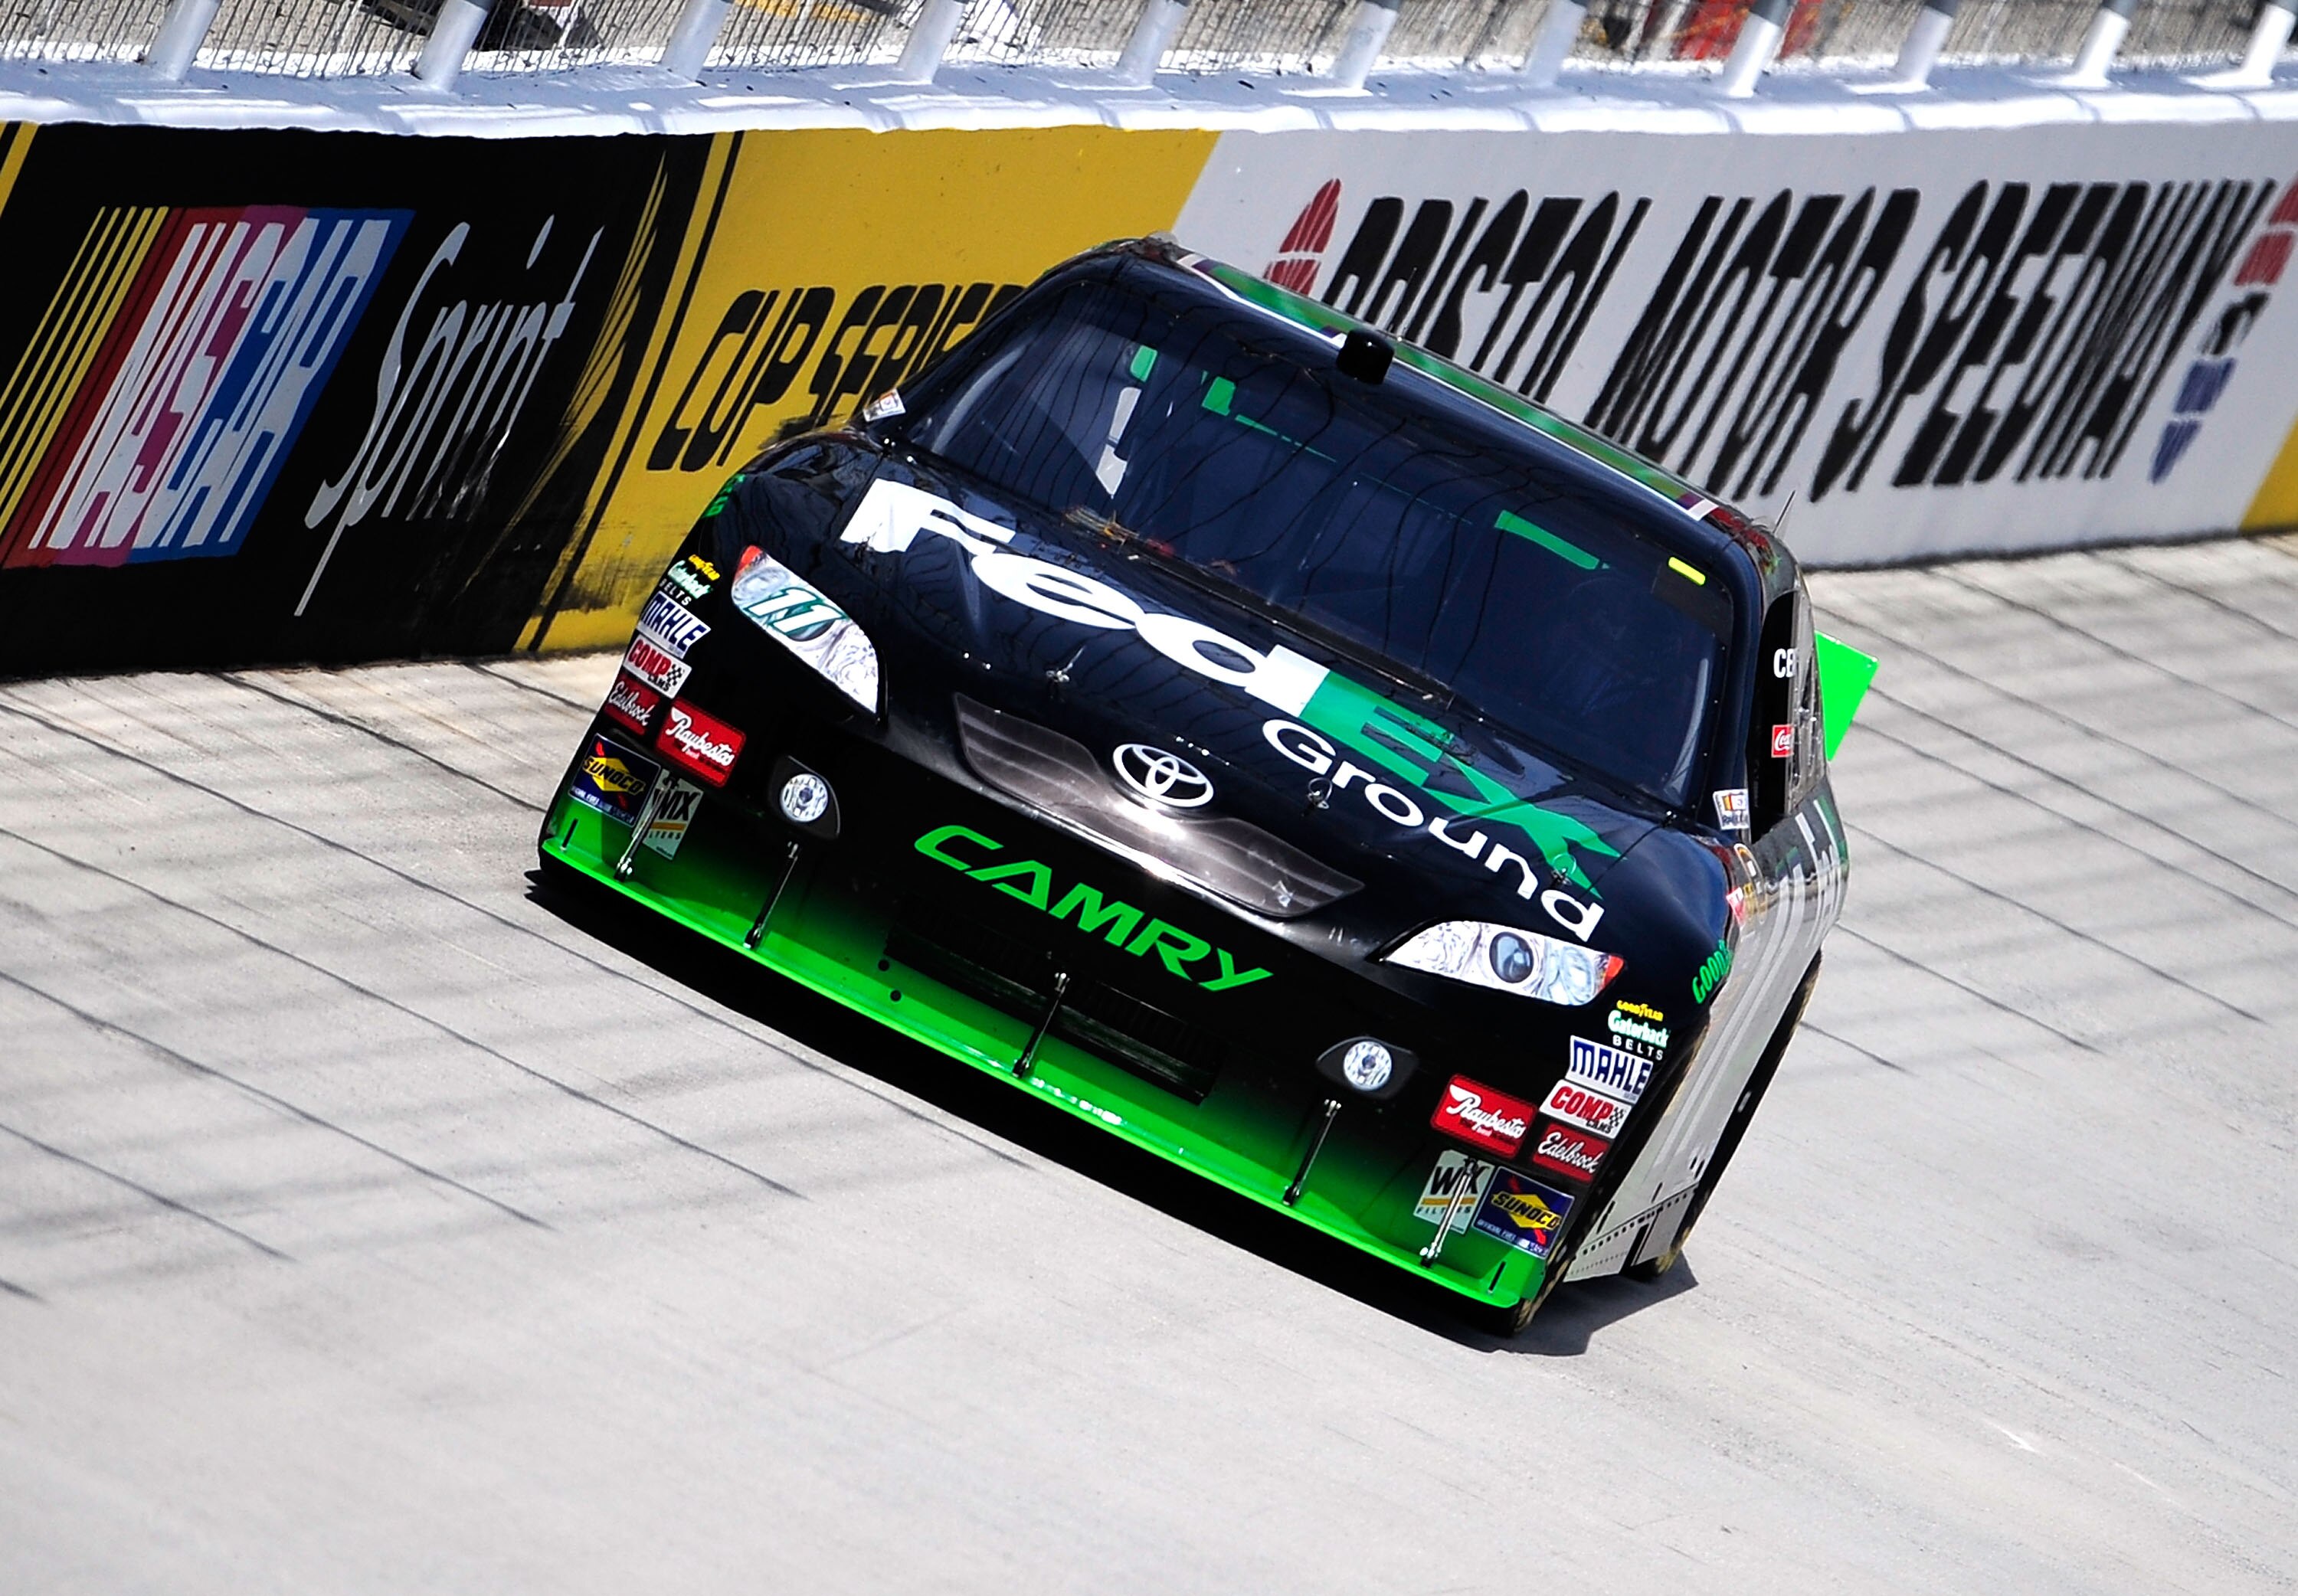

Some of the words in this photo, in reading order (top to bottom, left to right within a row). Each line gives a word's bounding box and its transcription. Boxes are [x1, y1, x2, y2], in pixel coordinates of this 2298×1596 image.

[1583, 186, 1920, 502] MOTOR
[1810, 178, 2278, 502] SPEEDWAY
[28, 217, 392, 549] NASCAR
[646, 286, 836, 473] CUP
[785, 283, 1027, 435] SERIE
[294, 215, 604, 616] Sprint
[659, 578, 692, 606] BELTS
[745, 587, 848, 636] 11
[642, 593, 708, 652] MAHLE
[627, 639, 673, 677] COMP
[664, 705, 735, 767] Raybestos
[584, 757, 645, 793] SUNOCO
[1262, 717, 1605, 943] Ground
[913, 824, 1275, 992] CAMRY
[1607, 1009, 1670, 1048] Gatorback
[1612, 1034, 1665, 1061] BELTS
[1571, 1039, 1652, 1095] MAHLE
[1445, 1084, 1527, 1139] Raybestos
[1550, 1085, 1614, 1122] COMP
[1585, 1118, 1614, 1134] CAMS
[1537, 1131, 1605, 1173] Edelbrock
[1429, 1165, 1491, 1195] WX
[1416, 1205, 1472, 1215] FILTS
[1493, 1193, 1561, 1228] SUNOCO
